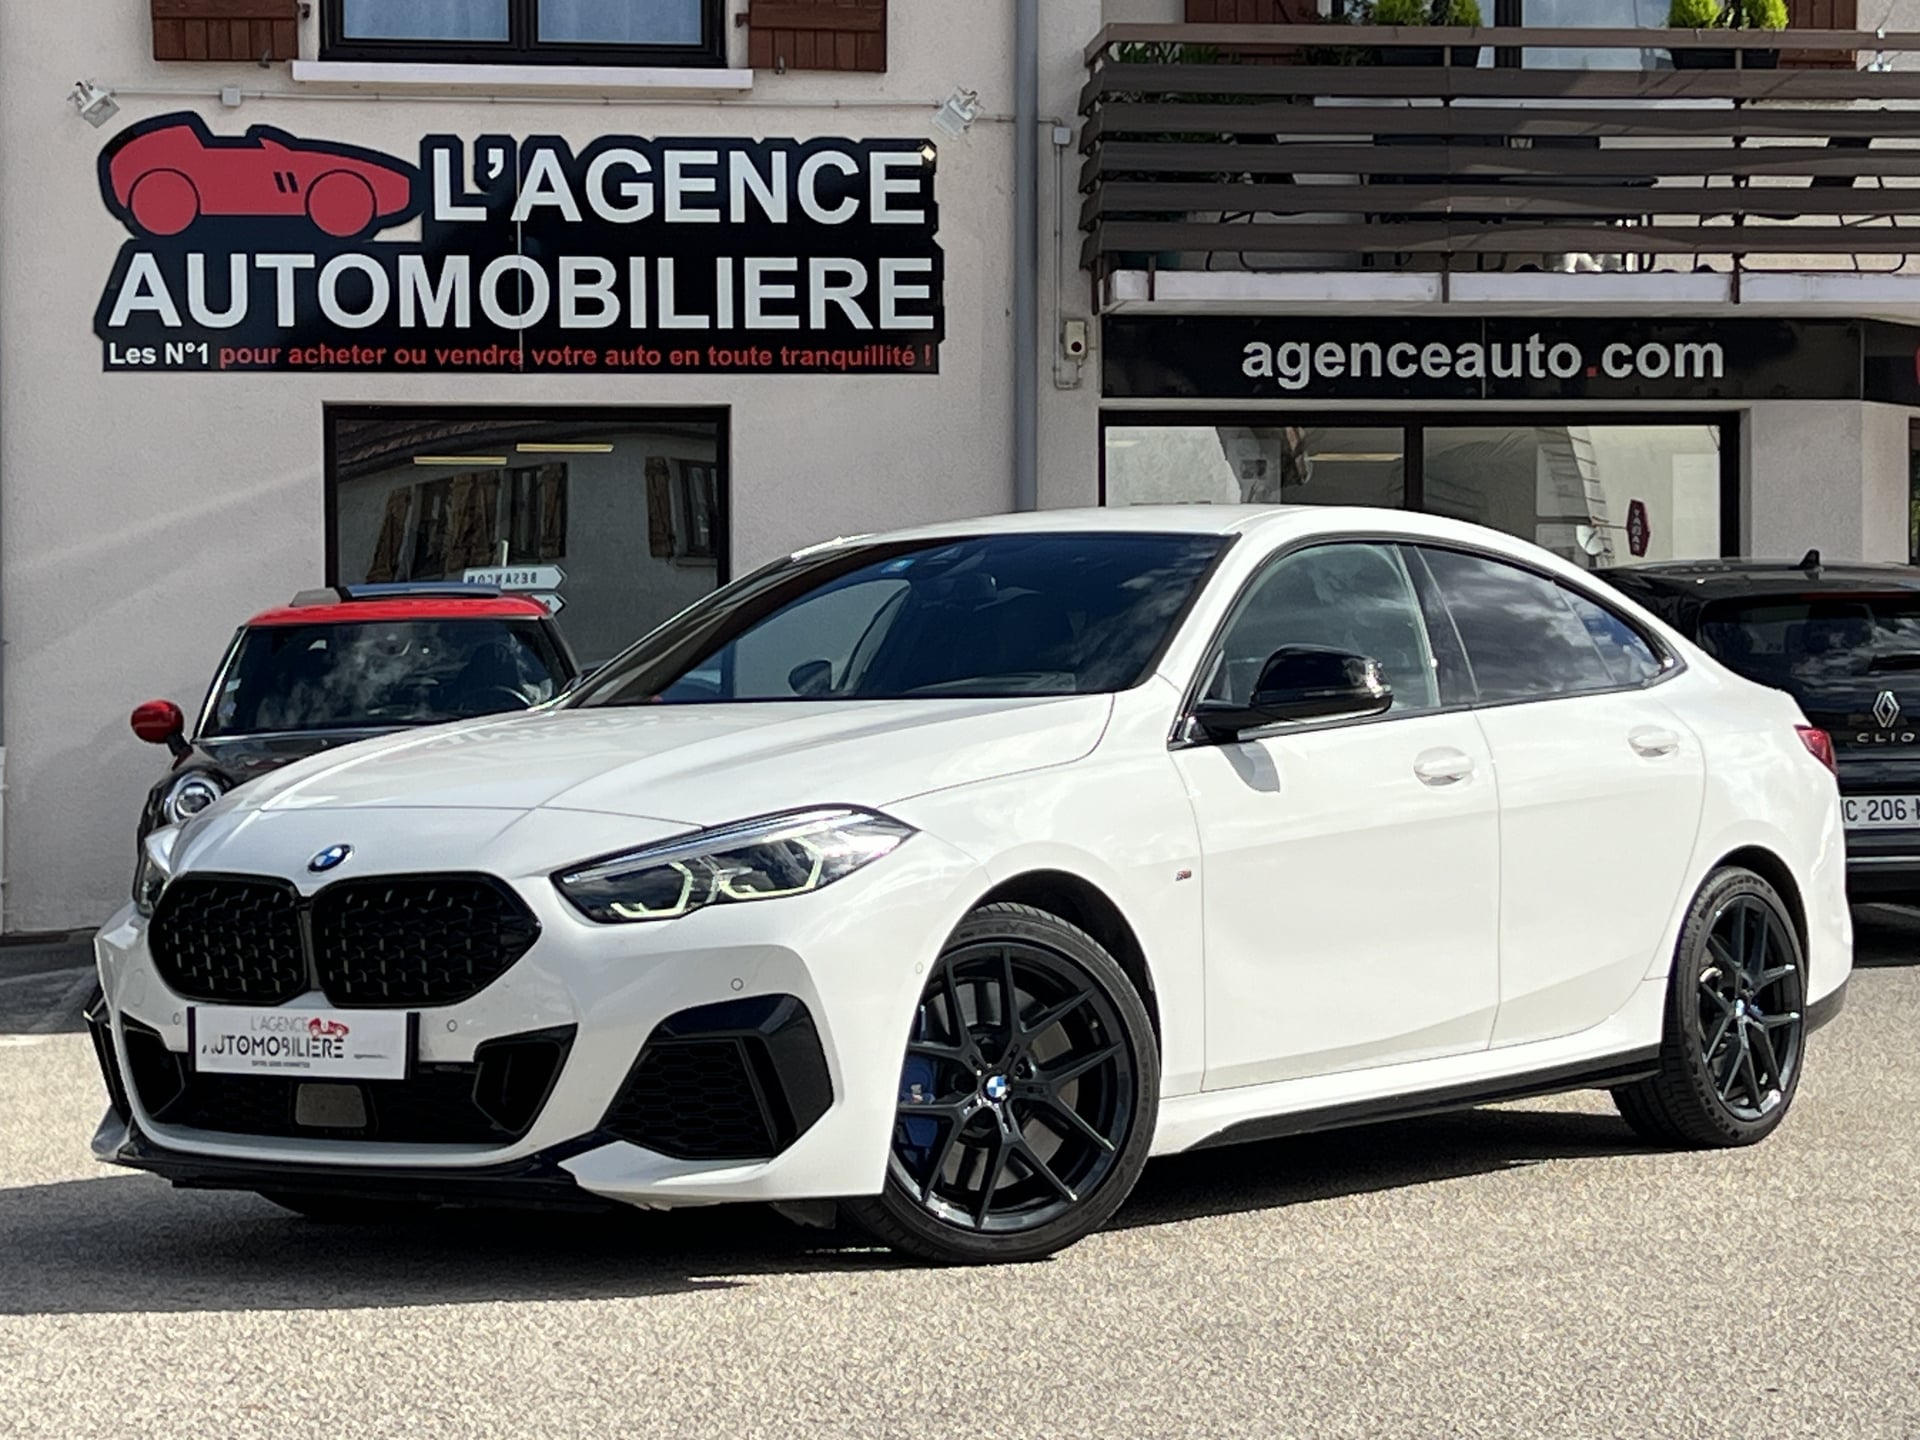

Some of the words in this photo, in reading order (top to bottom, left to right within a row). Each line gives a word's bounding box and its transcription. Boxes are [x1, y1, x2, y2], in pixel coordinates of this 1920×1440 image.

[433, 148, 925, 225] L'AGENCE
[107, 252, 935, 330] AUTOMOBILIERE
[109, 342, 157, 365] Les
[165, 342, 209, 365] N°1
[219, 346, 279, 369] pour
[288, 345, 388, 365] acheter
[394, 347, 427, 365] ou
[434, 344, 524, 366] vendre
[532, 346, 598, 366] votre
[604, 346, 661, 366] auto
[669, 349, 700, 366] en
[708, 346, 773, 366] toute
[781, 344, 916, 370] tranquillité
[1241, 332, 1725, 389] agenceauto.com
[1856, 732, 1916, 743] CLIO
